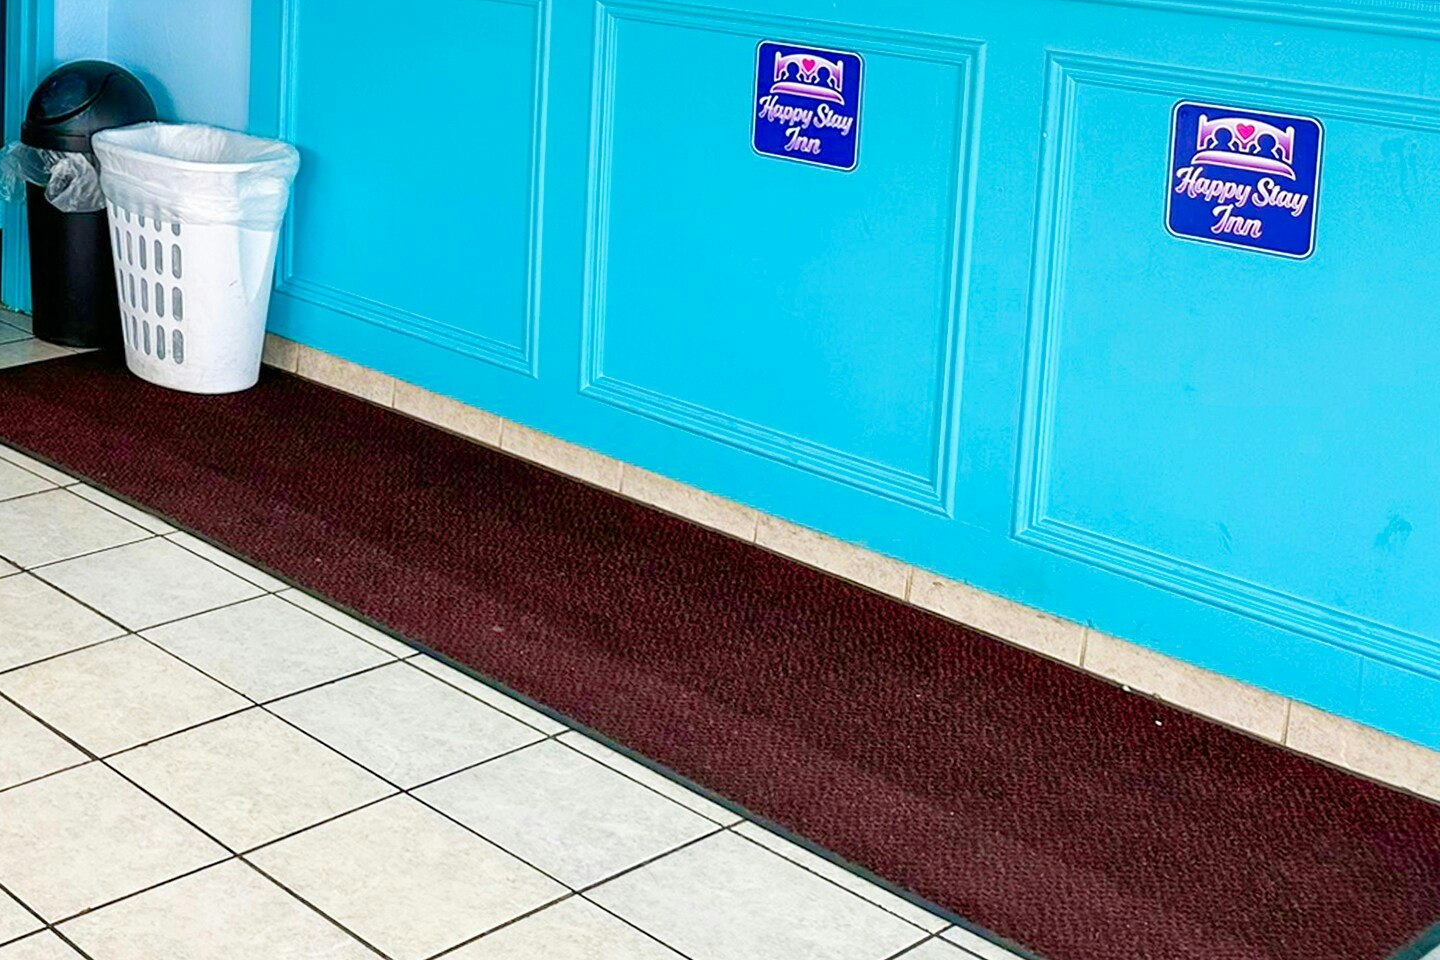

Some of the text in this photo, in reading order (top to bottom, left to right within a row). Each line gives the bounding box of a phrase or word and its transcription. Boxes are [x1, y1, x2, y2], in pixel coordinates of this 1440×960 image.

[758, 95, 854, 136] Happy Stay
[784, 126, 822, 155] Inn
[1174, 166, 1309, 217] Happy Stay
[1211, 204, 1263, 239] Inn
